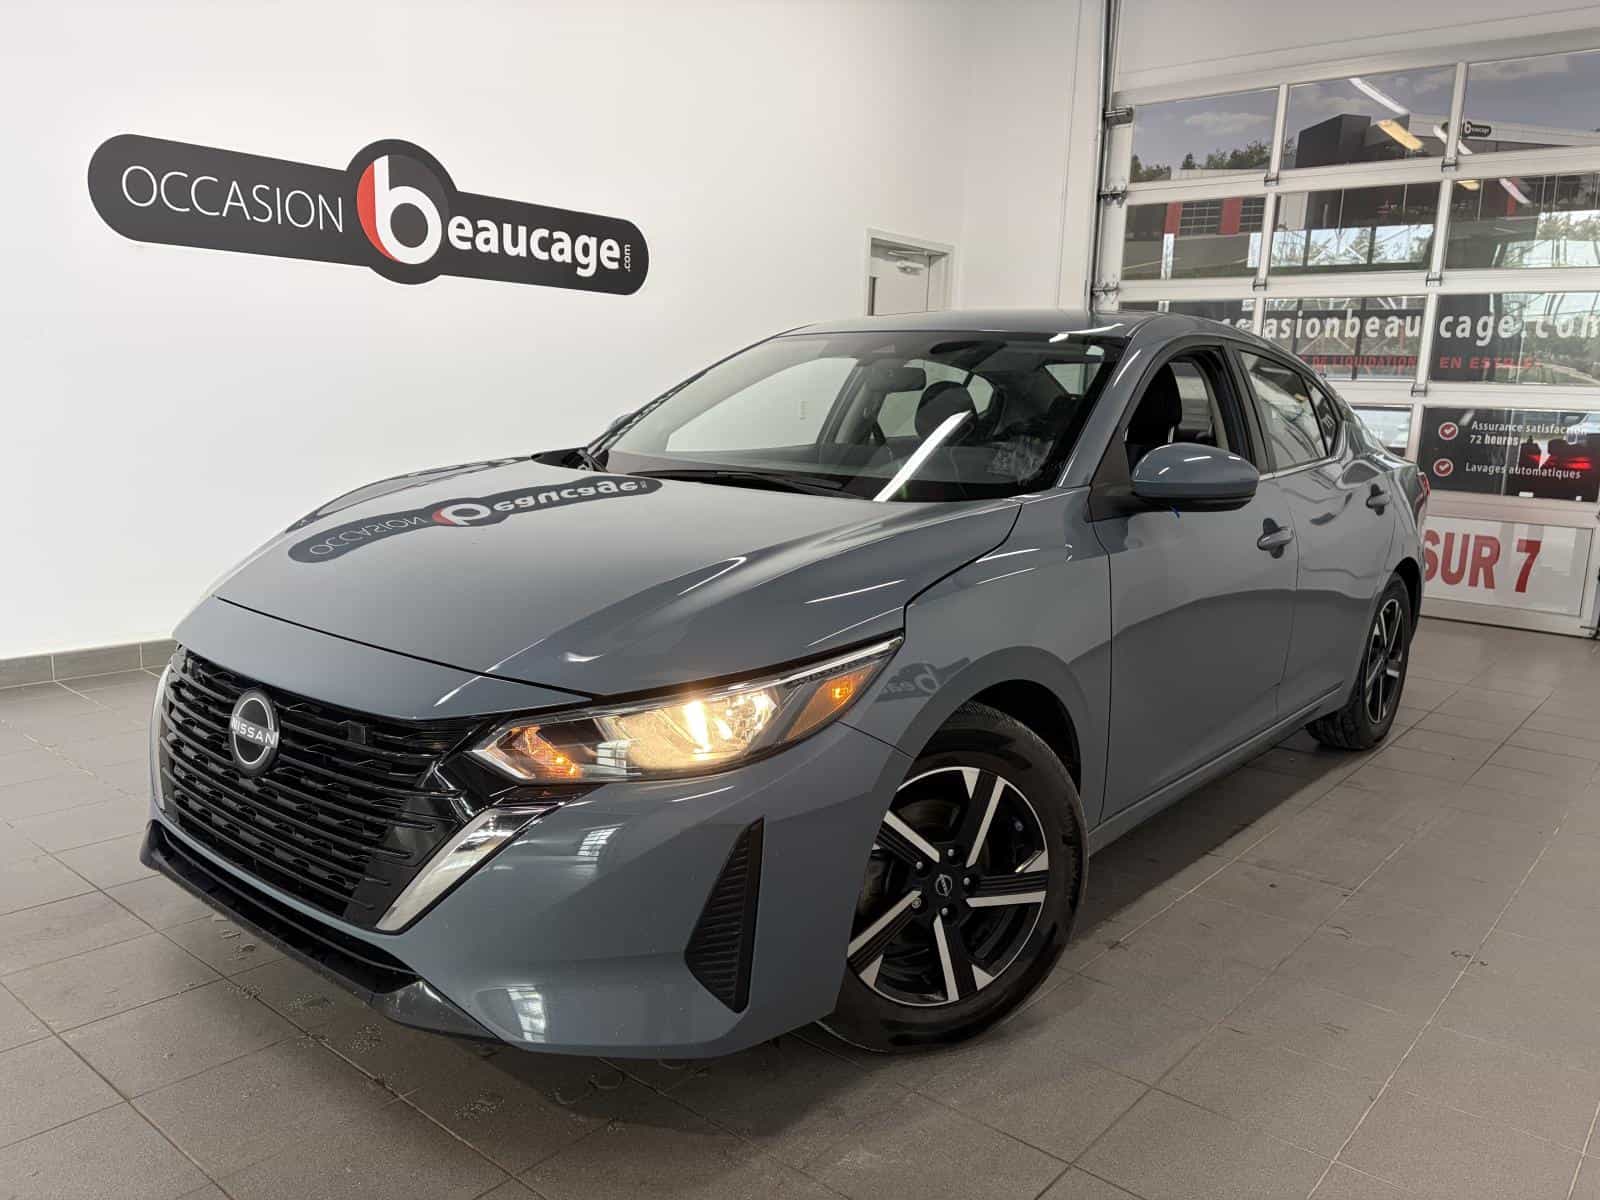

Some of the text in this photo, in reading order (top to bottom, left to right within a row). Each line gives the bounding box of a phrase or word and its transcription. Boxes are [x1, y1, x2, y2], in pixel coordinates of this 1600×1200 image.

[121, 164, 343, 233] OCCASION
[1439, 356, 1462, 368] EN
[1471, 420, 1523, 432] Assurance
[1470, 434, 1482, 444] 72
[1465, 461, 1581, 480] Lavages automatiques
[1424, 528, 1542, 593] SUR 7
[231, 715, 277, 746] NISSAN
